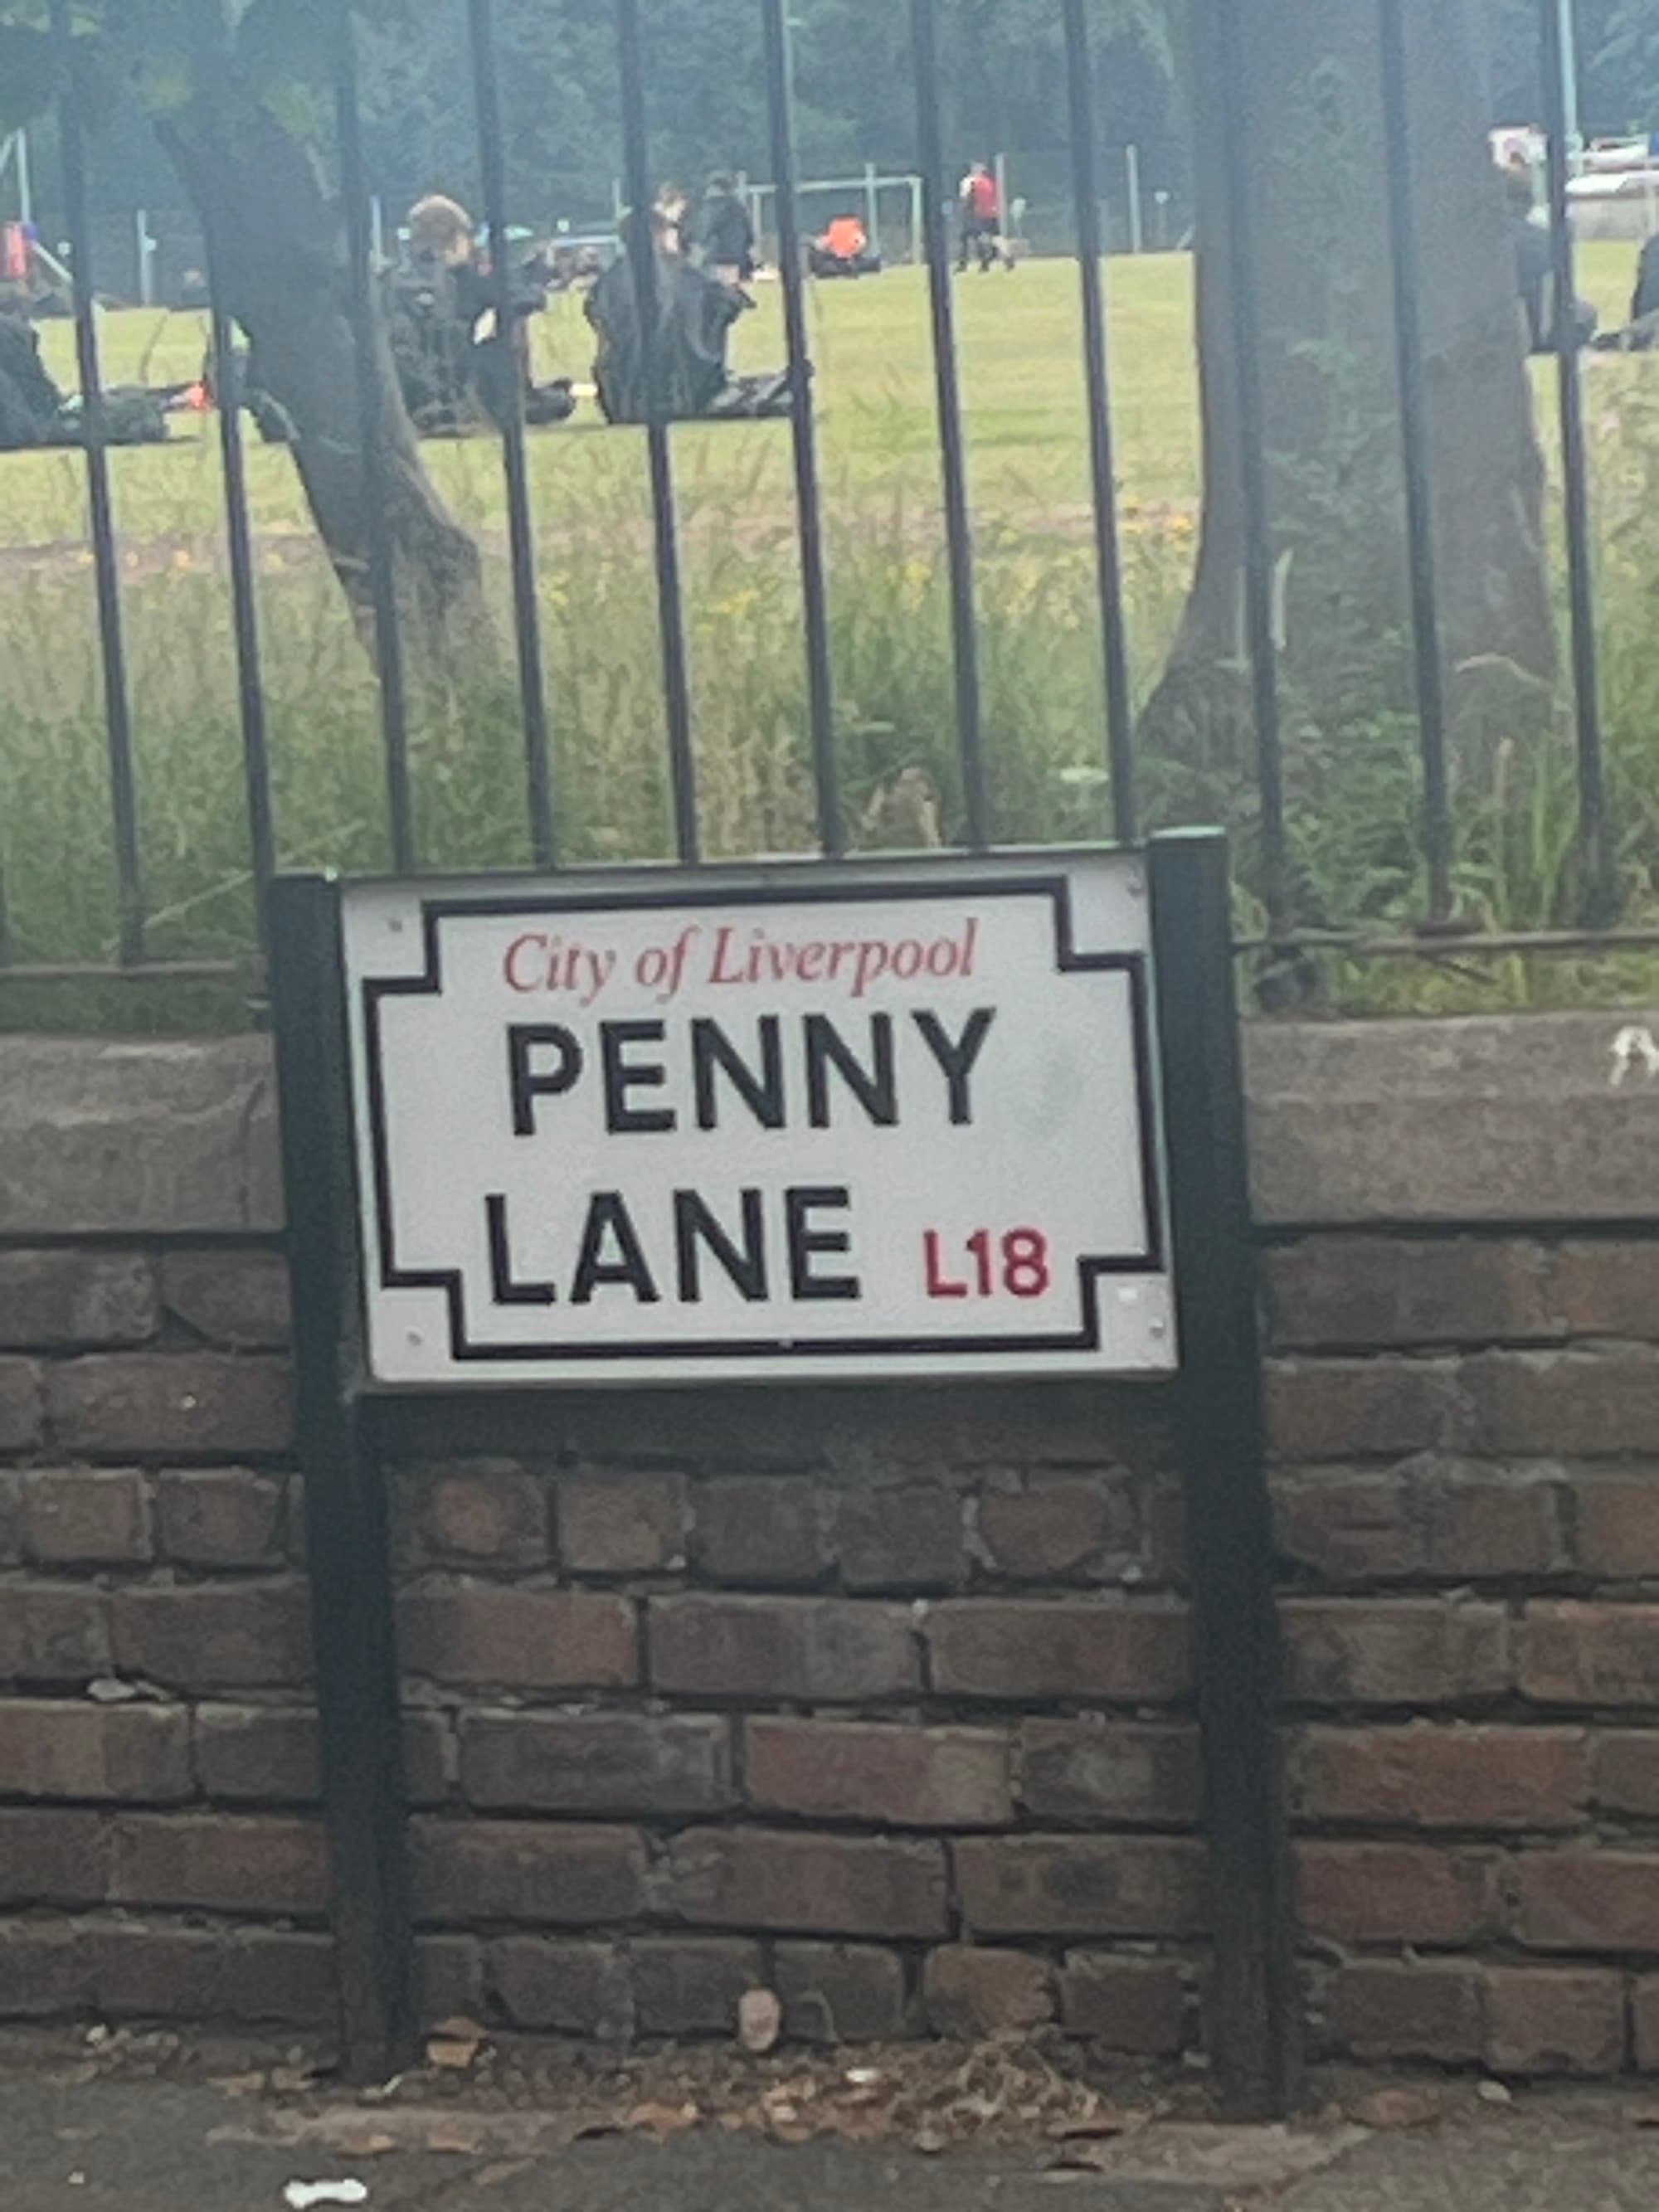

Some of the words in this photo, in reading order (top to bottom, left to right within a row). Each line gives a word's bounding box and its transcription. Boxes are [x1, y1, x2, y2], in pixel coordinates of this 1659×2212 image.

[503, 930, 616, 1007] City
[636, 926, 699, 1004] of
[708, 916, 980, 997] Liverpool
[505, 1006, 997, 1136] PENNY
[484, 1185, 862, 1305] LANE
[922, 1228, 1051, 1299] L18
